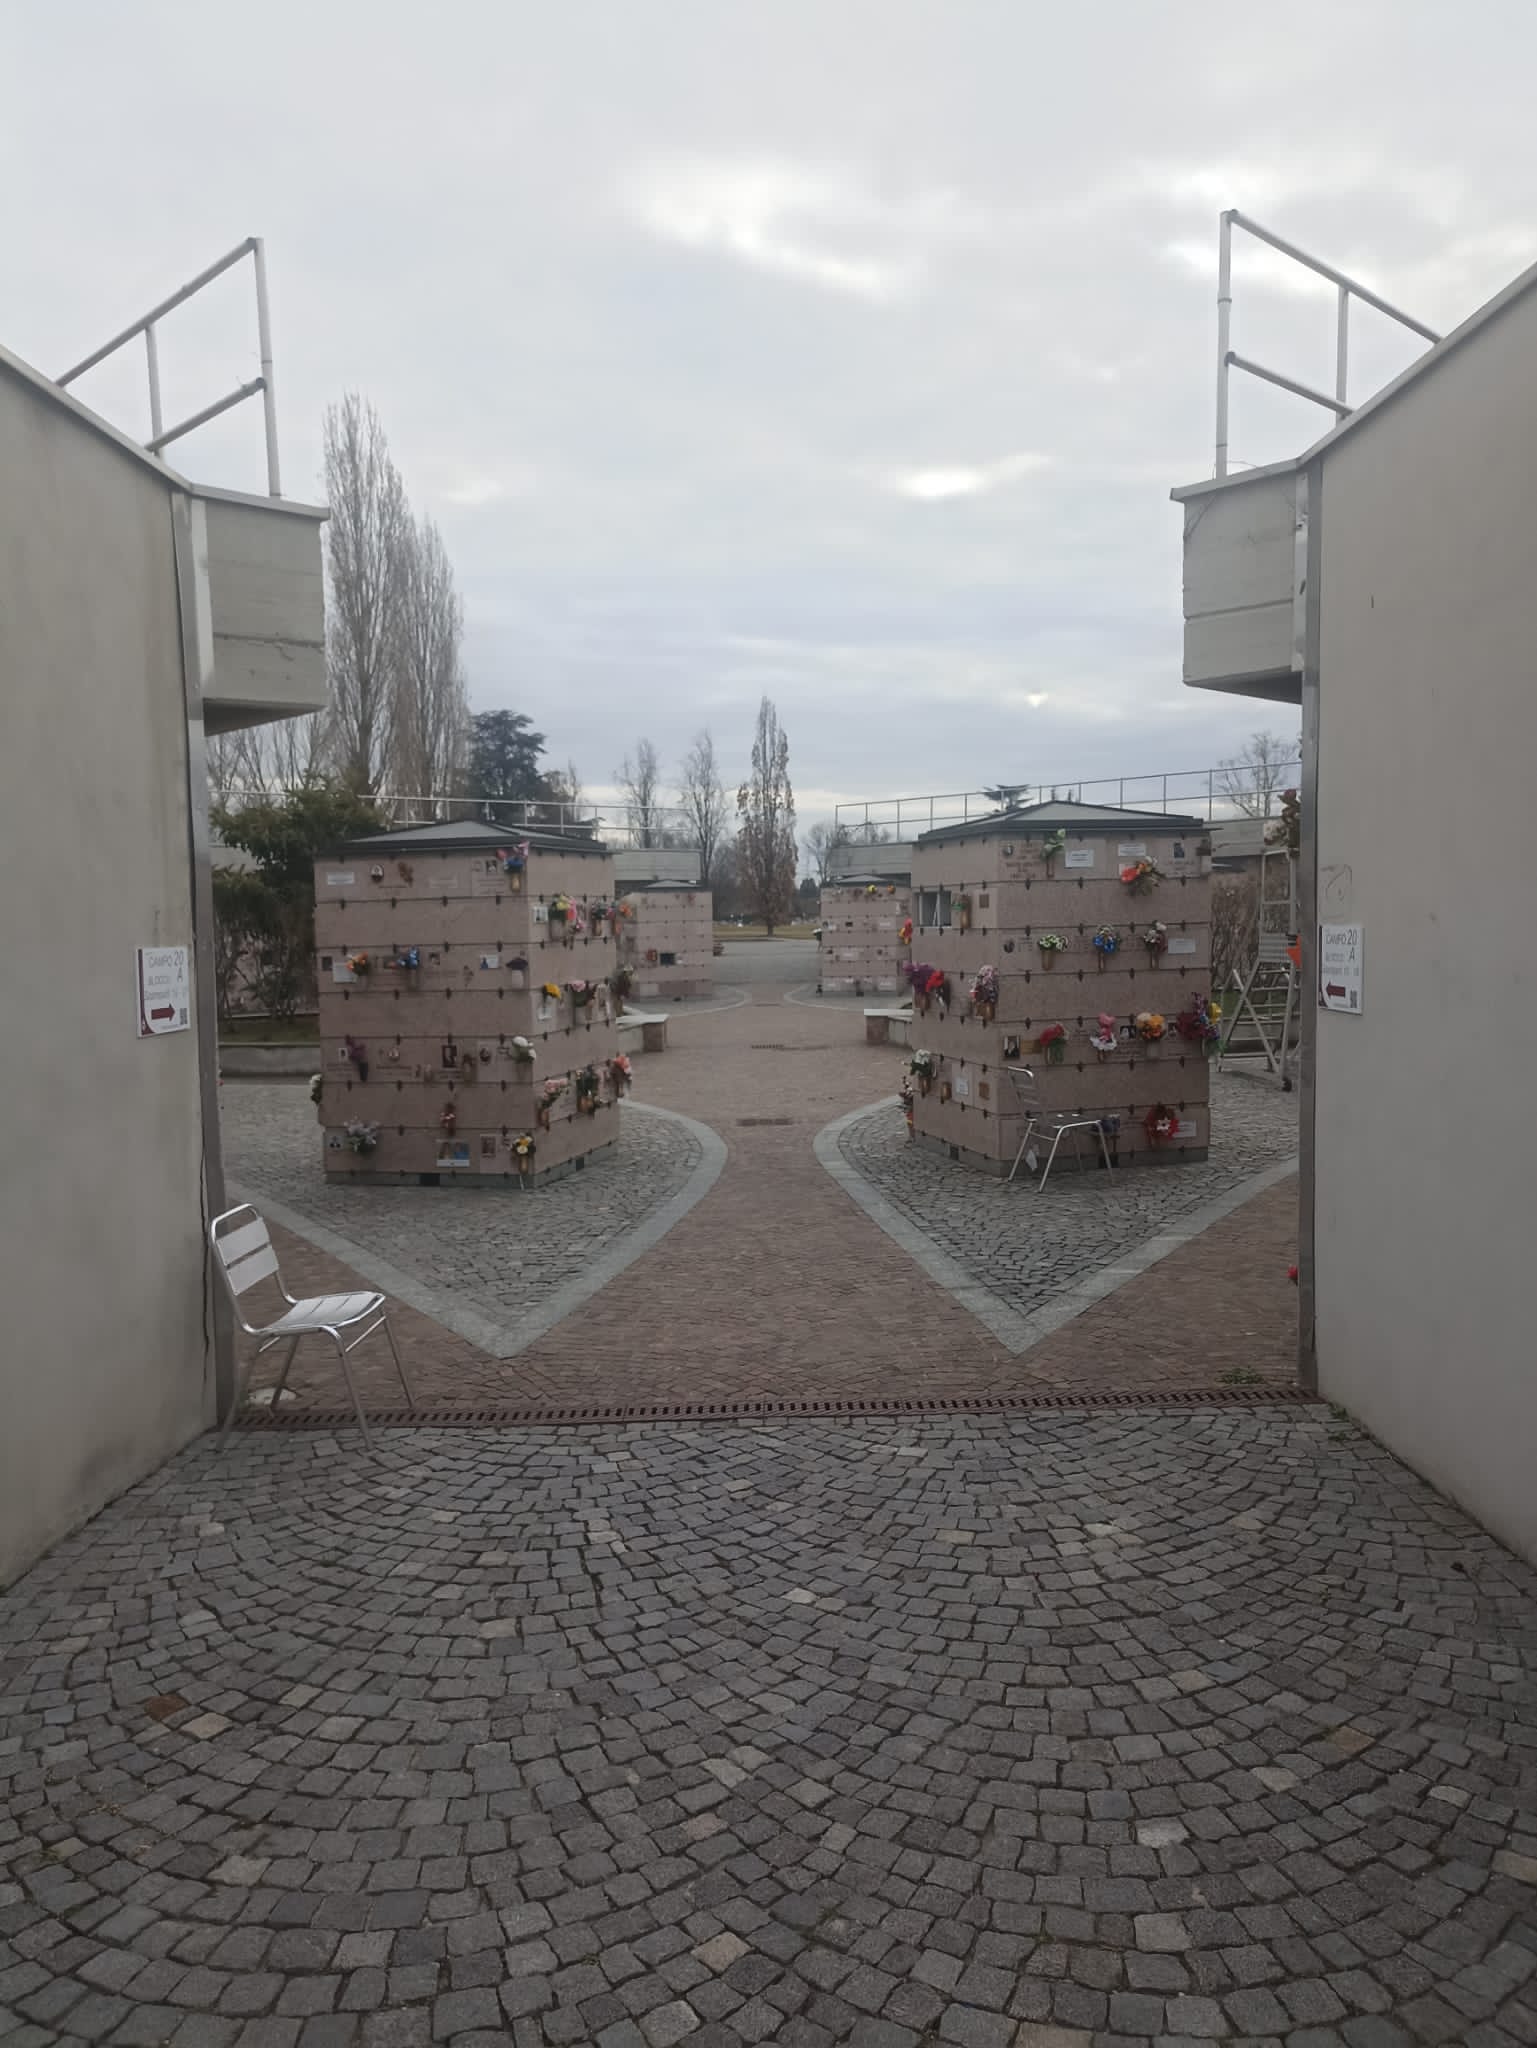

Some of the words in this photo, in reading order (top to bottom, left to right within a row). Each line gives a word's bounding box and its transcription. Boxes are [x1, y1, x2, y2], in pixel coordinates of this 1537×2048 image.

[1325, 933, 1346, 944] CAMPO
[1347, 929, 1357, 945] 20
[148, 955, 172, 968] CAMPO
[174, 950, 184, 966] 20
[1348, 946, 1355, 961] A
[177, 967, 183, 982] A
